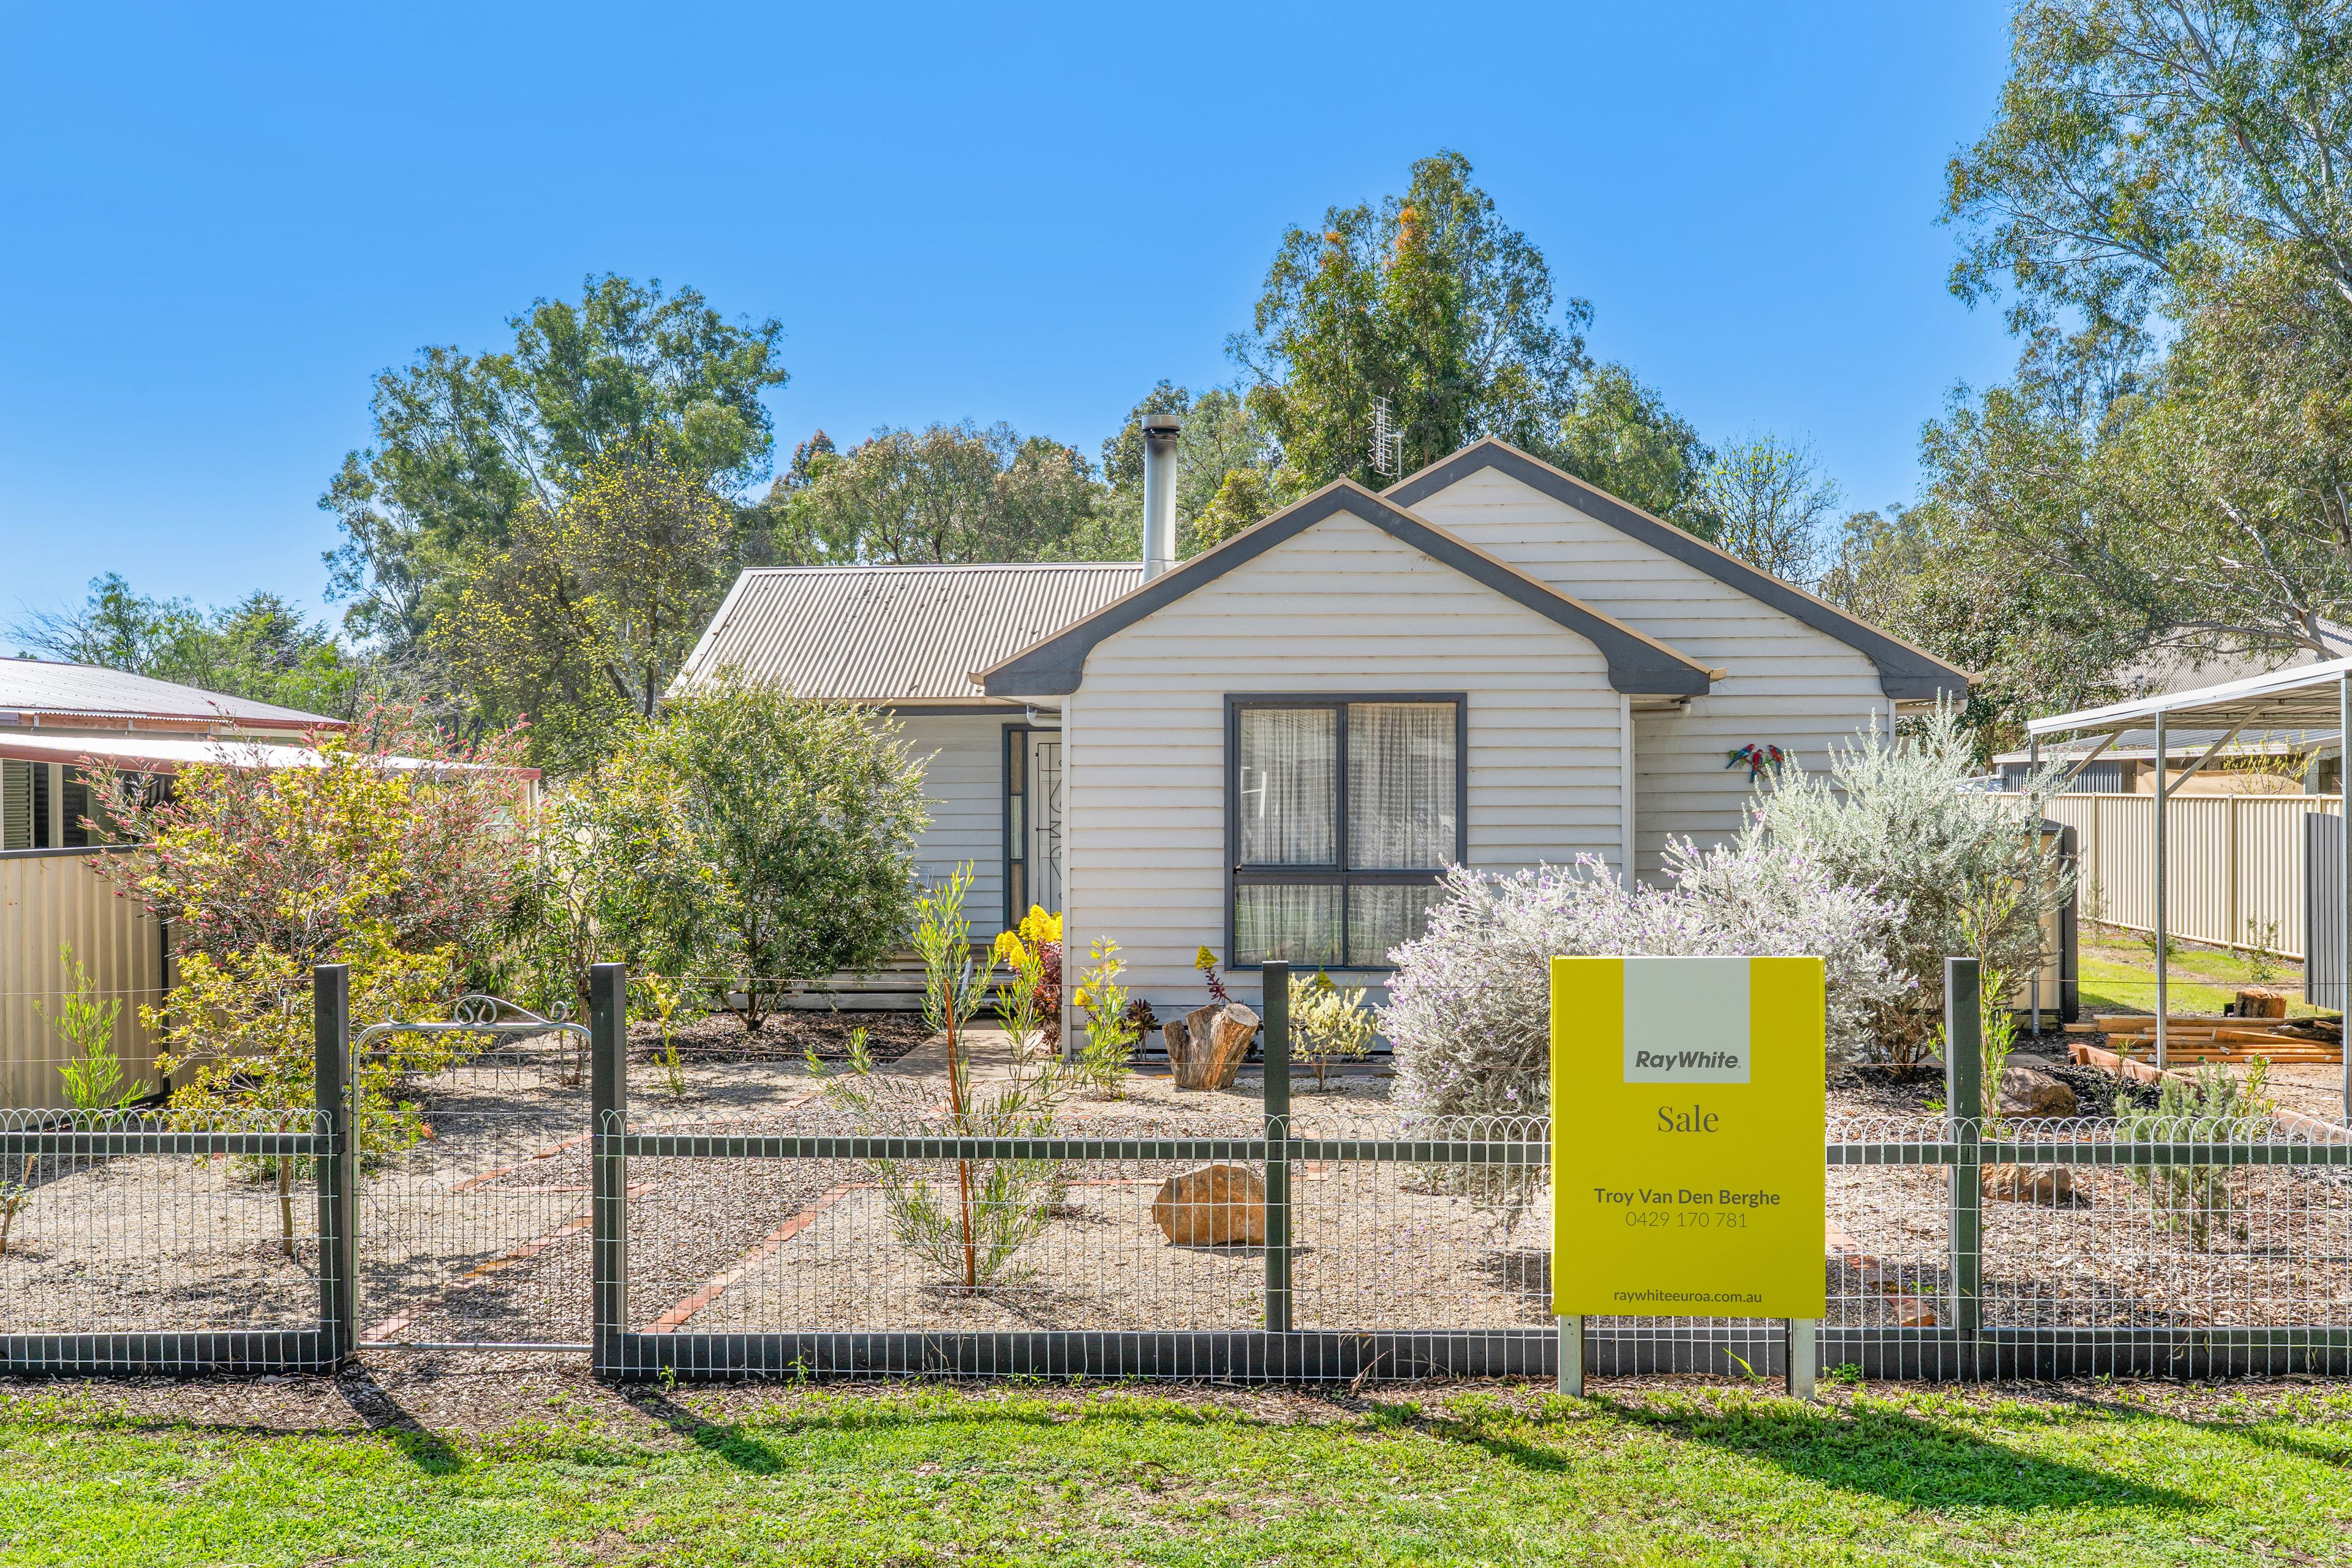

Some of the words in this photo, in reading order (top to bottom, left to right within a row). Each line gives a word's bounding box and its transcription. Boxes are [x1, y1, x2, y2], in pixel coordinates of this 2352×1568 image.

[1657, 1104, 1719, 1133] Sale
[1594, 1188, 1634, 1207] Troy
[1638, 1188, 1673, 1204] Van
[1678, 1189, 1713, 1205] Den
[1719, 1189, 1781, 1208] Berghe
[1625, 1212, 1670, 1227] 0429
[1677, 1212, 1710, 1227] 170
[1715, 1213, 1747, 1228] 781
[1613, 1288, 1762, 1303] raywhiteeuroa.com.au
